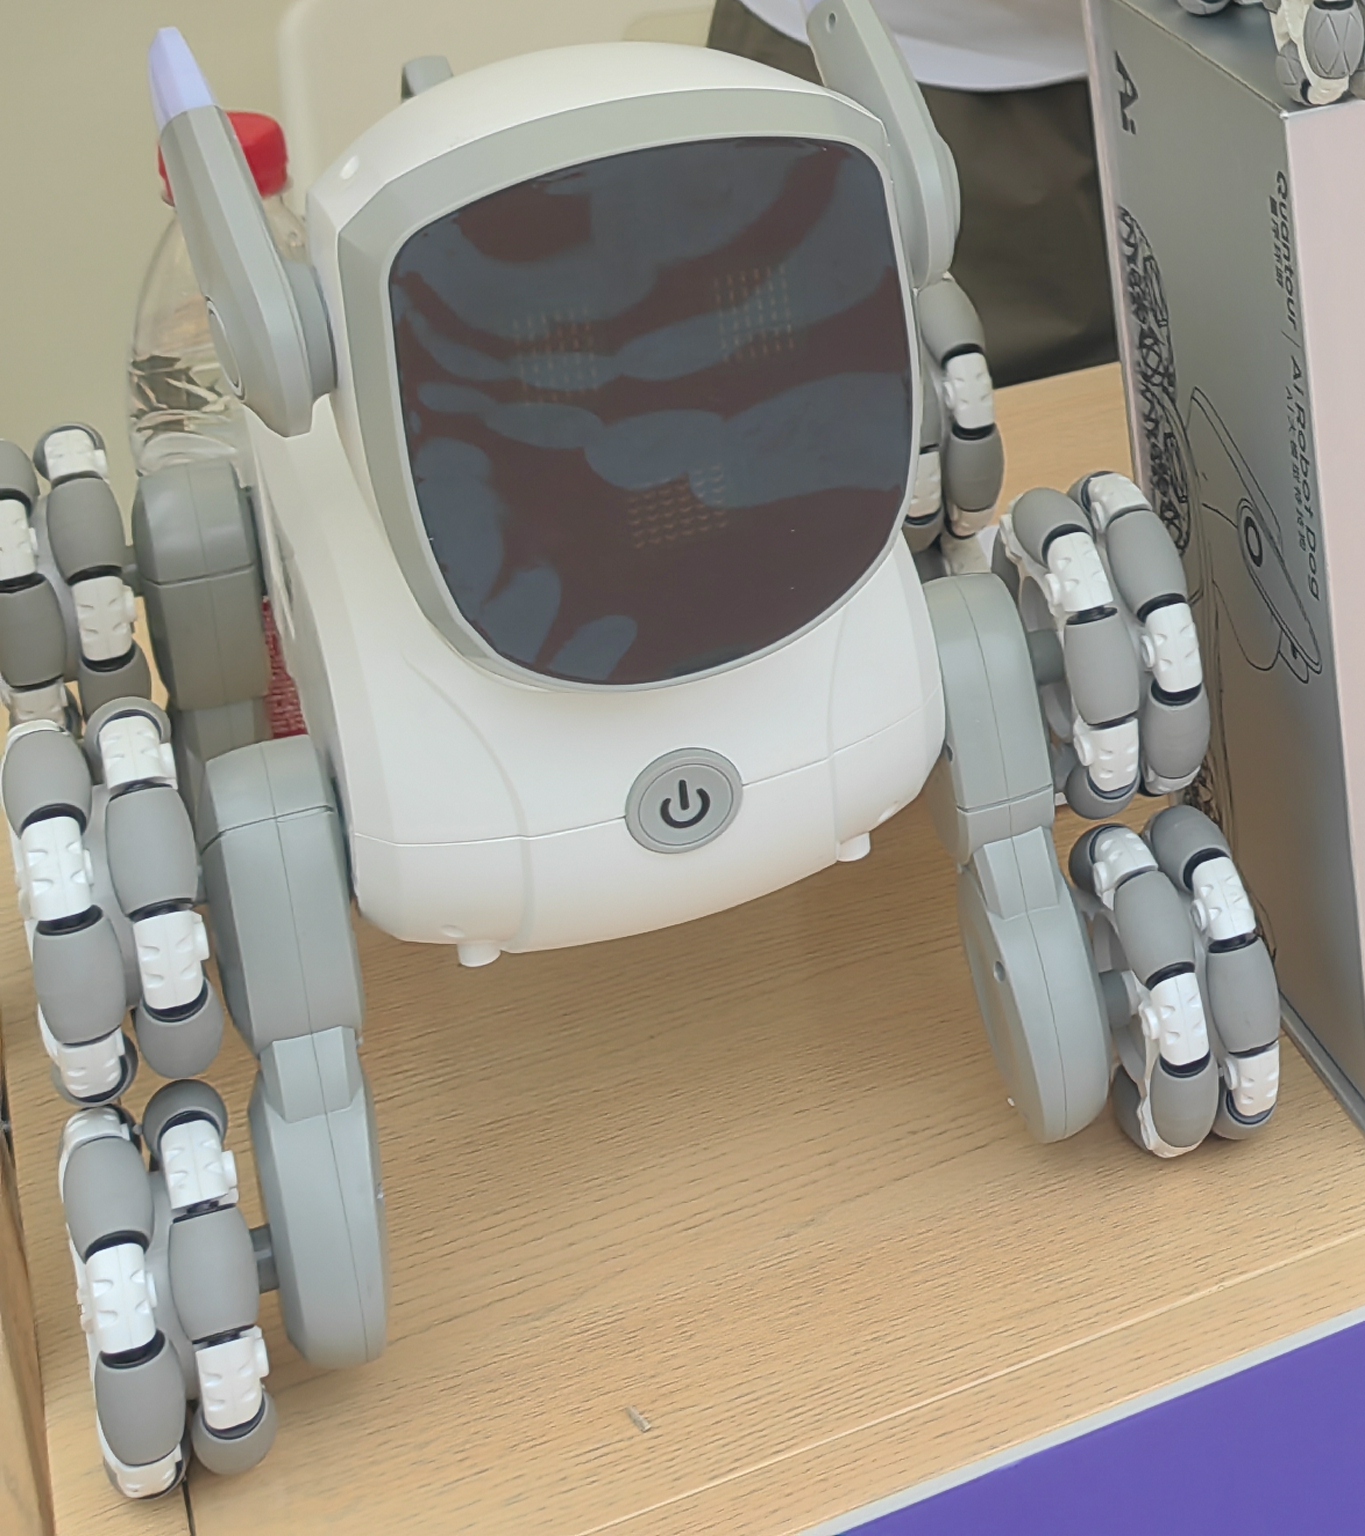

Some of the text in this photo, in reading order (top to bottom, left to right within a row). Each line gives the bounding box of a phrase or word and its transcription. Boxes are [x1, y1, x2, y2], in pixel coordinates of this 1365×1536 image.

[1277, 170, 1298, 331] Quantour
[1296, 401, 1314, 519] Robot
[1305, 524, 1321, 602] Dog
